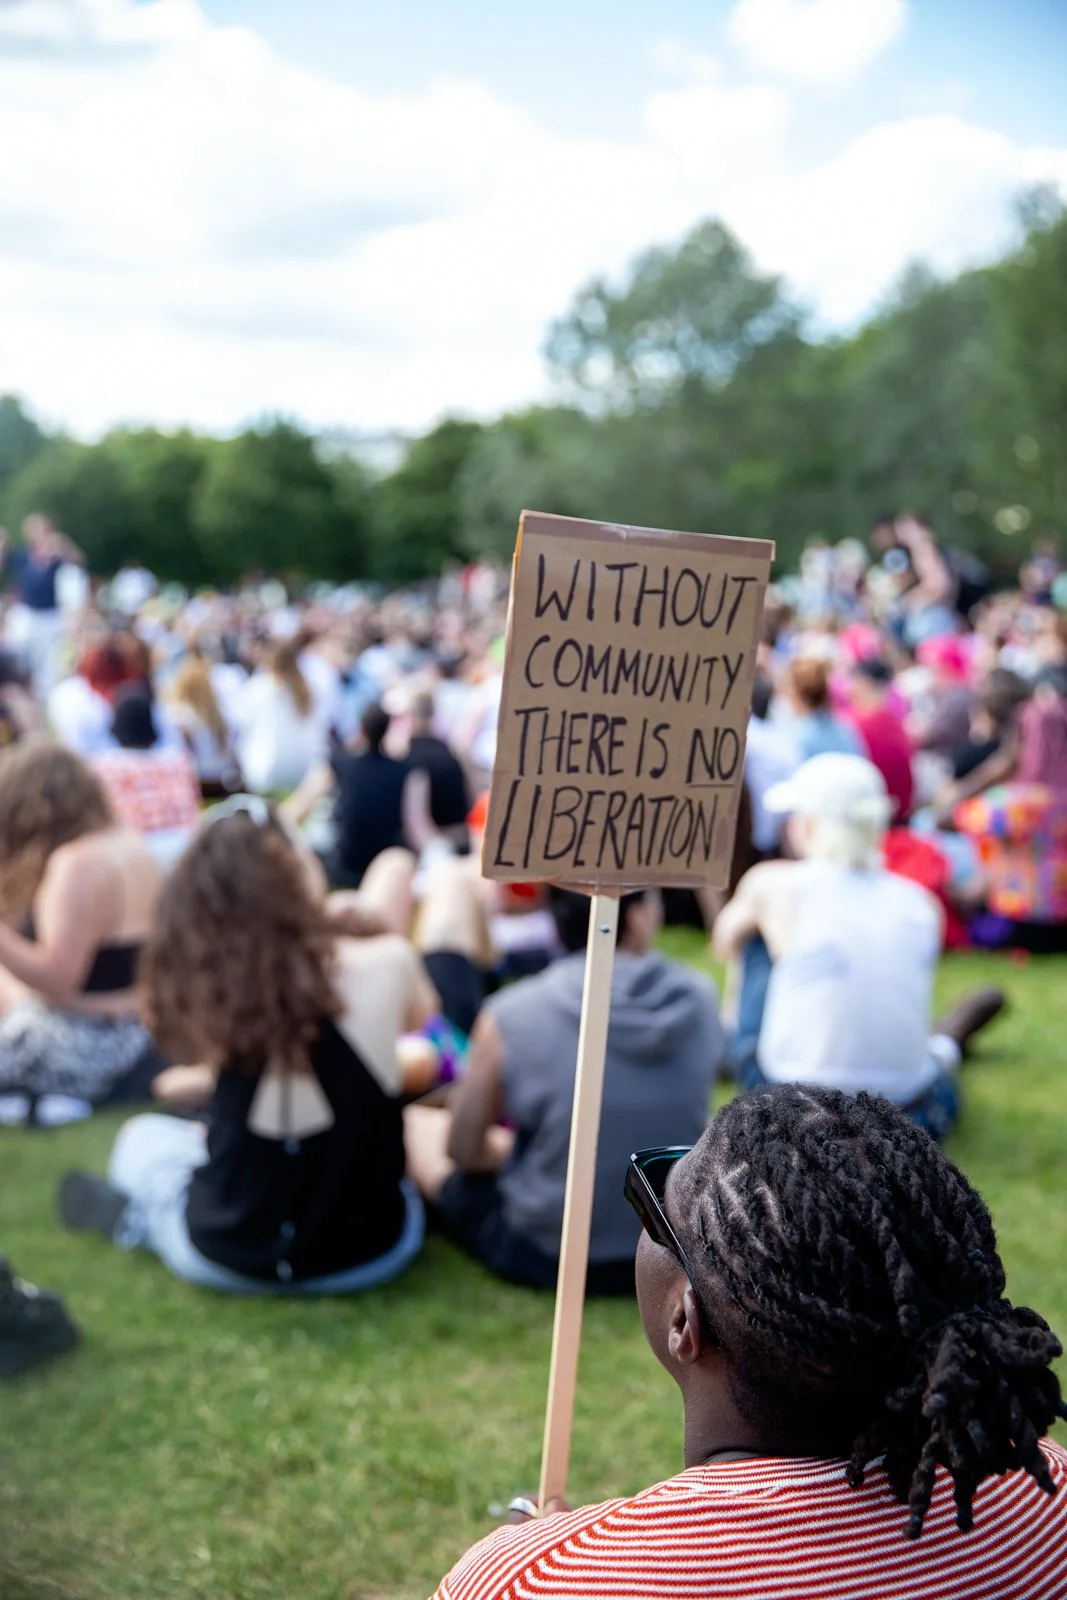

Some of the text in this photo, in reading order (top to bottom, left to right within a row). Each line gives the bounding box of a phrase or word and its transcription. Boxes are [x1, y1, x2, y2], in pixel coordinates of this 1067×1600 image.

[535, 554, 758, 635] WITHOUT
[524, 635, 744, 710] COMMUNITY
[515, 706, 740, 784] THERE IS NO
[494, 779, 718, 869] LIBERATION
